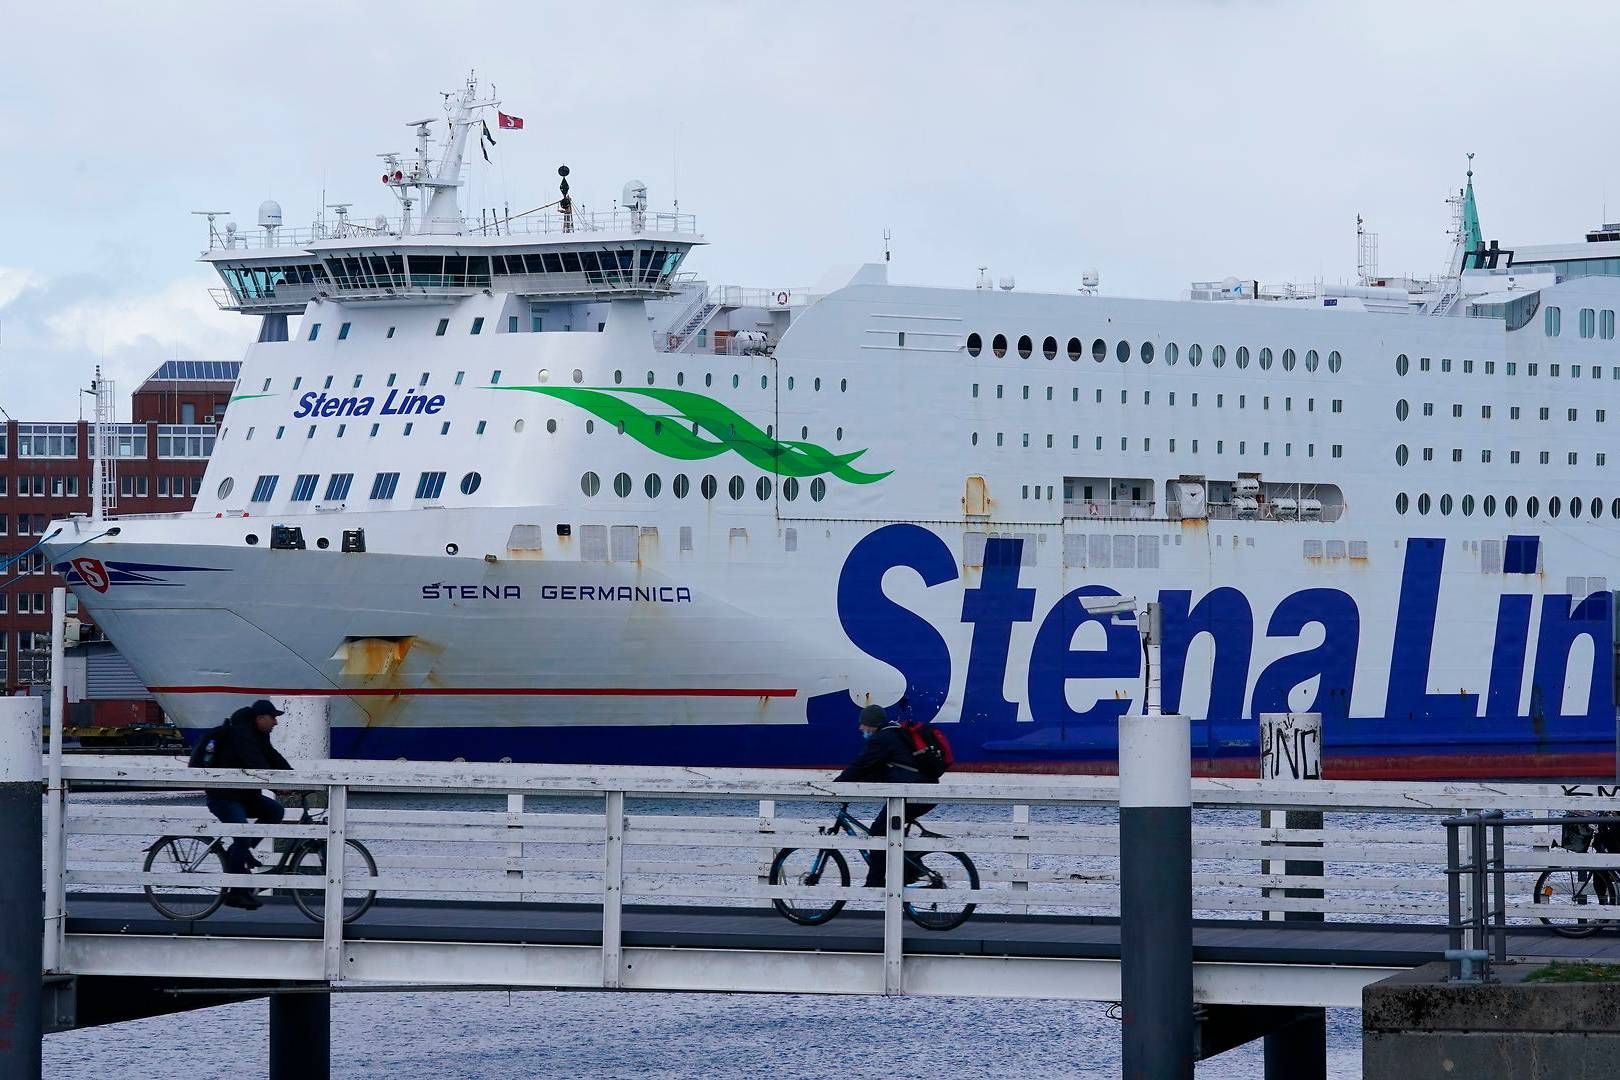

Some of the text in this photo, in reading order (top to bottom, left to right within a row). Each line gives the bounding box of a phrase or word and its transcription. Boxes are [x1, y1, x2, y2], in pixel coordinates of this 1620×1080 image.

[293, 388, 445, 418] Stena Line
[79, 561, 105, 587] S
[422, 585, 691, 602] STENA GERMANICA
[806, 522, 1360, 724] Stena
